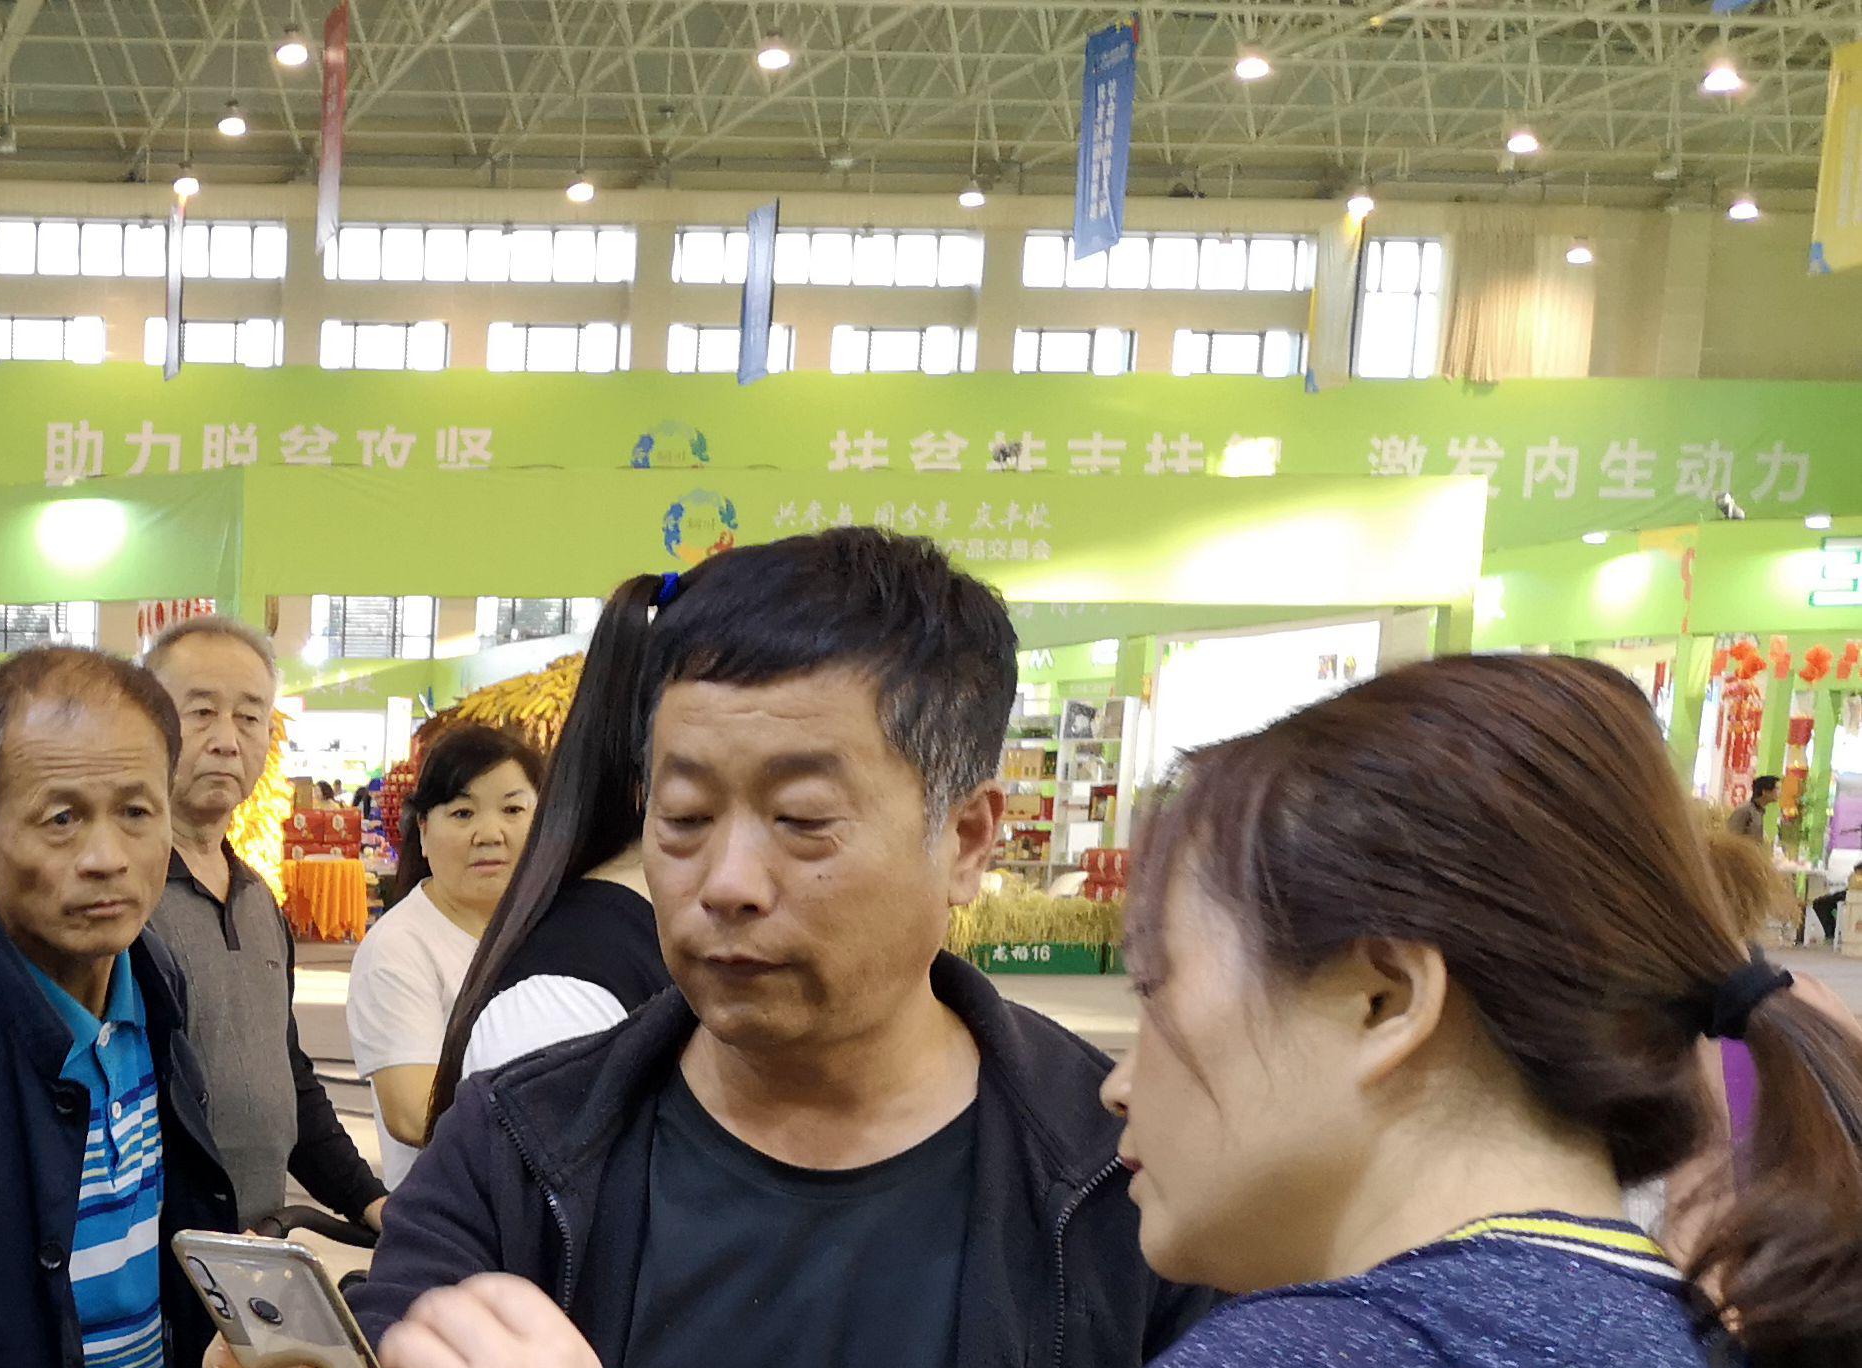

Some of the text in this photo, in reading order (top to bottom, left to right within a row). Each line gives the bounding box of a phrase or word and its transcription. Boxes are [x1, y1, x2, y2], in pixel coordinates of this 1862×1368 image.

[1368, 435, 1811, 501] 激发内生动力
